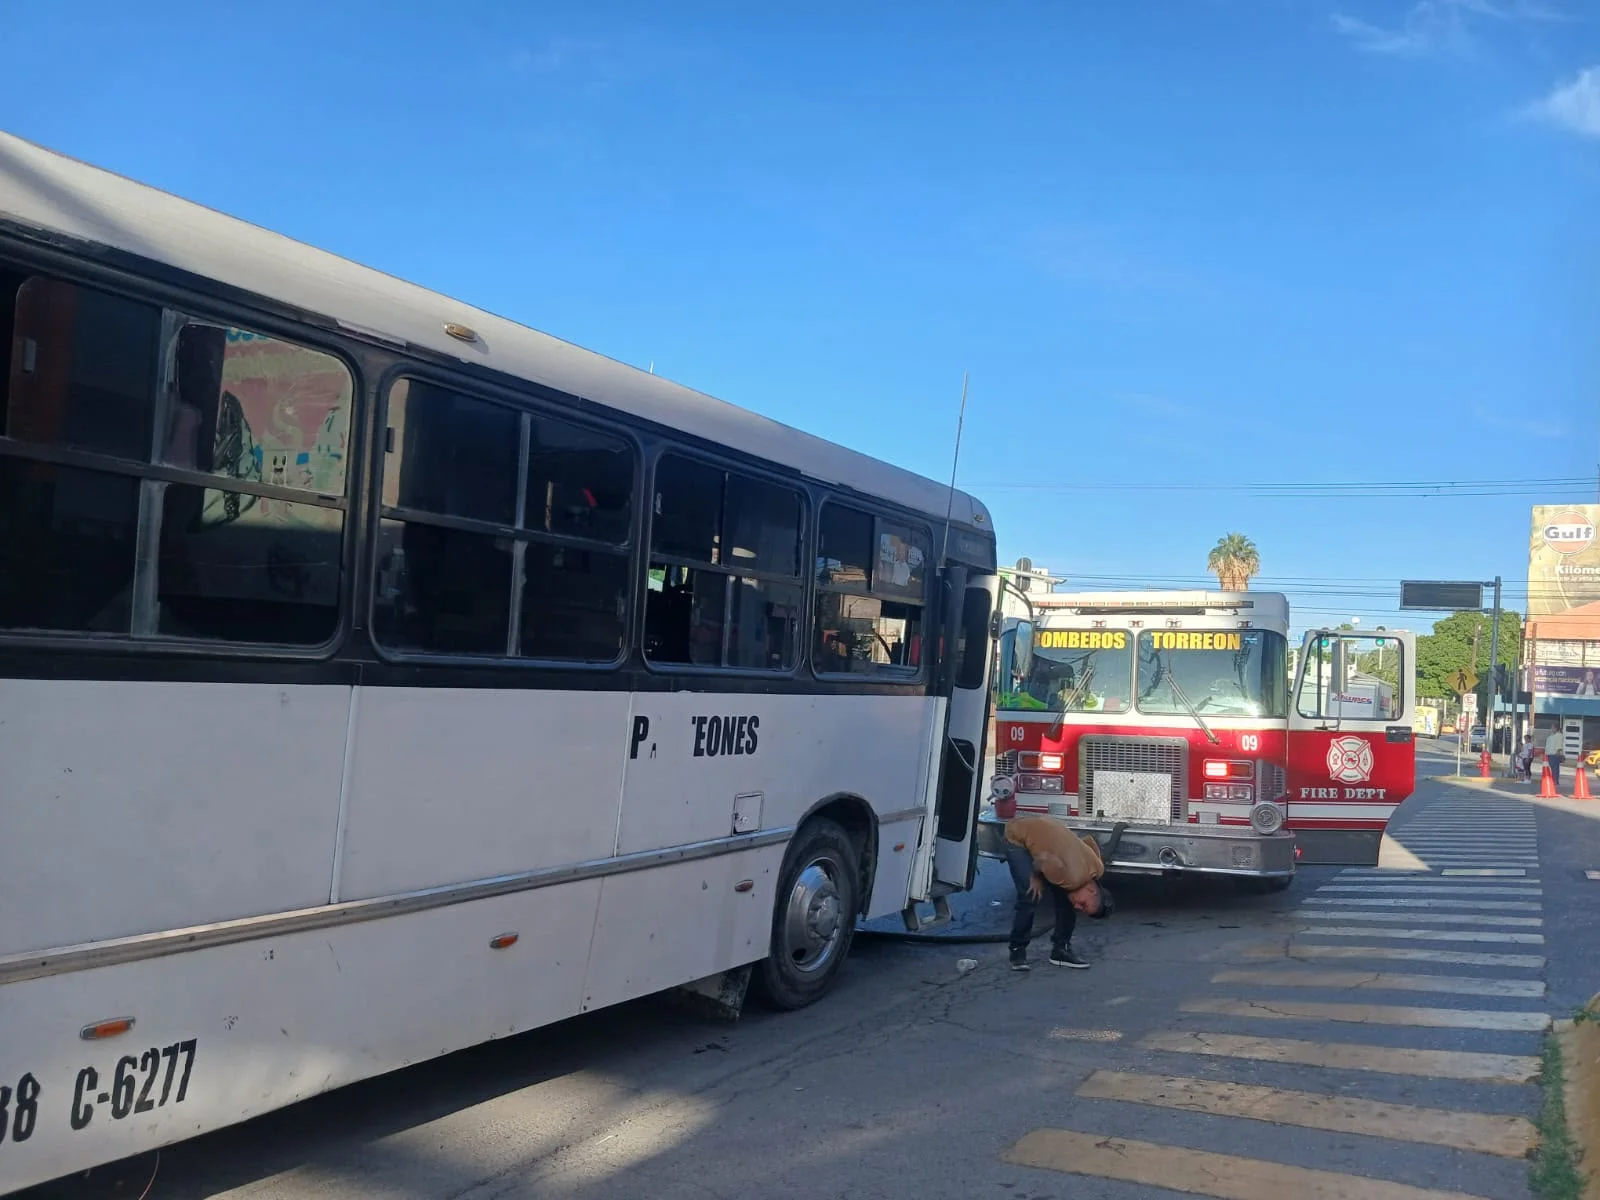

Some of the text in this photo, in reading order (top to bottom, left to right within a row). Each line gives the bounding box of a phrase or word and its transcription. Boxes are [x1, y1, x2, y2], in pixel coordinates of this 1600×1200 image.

[1544, 526, 1593, 539] Gulf
[1151, 631, 1241, 650] TORREON
[1010, 726, 1025, 742] 09
[1242, 734, 1258, 751] 09
[1300, 787, 1386, 800] FIRE DEPT
[71, 1038, 197, 1131] C-6277
